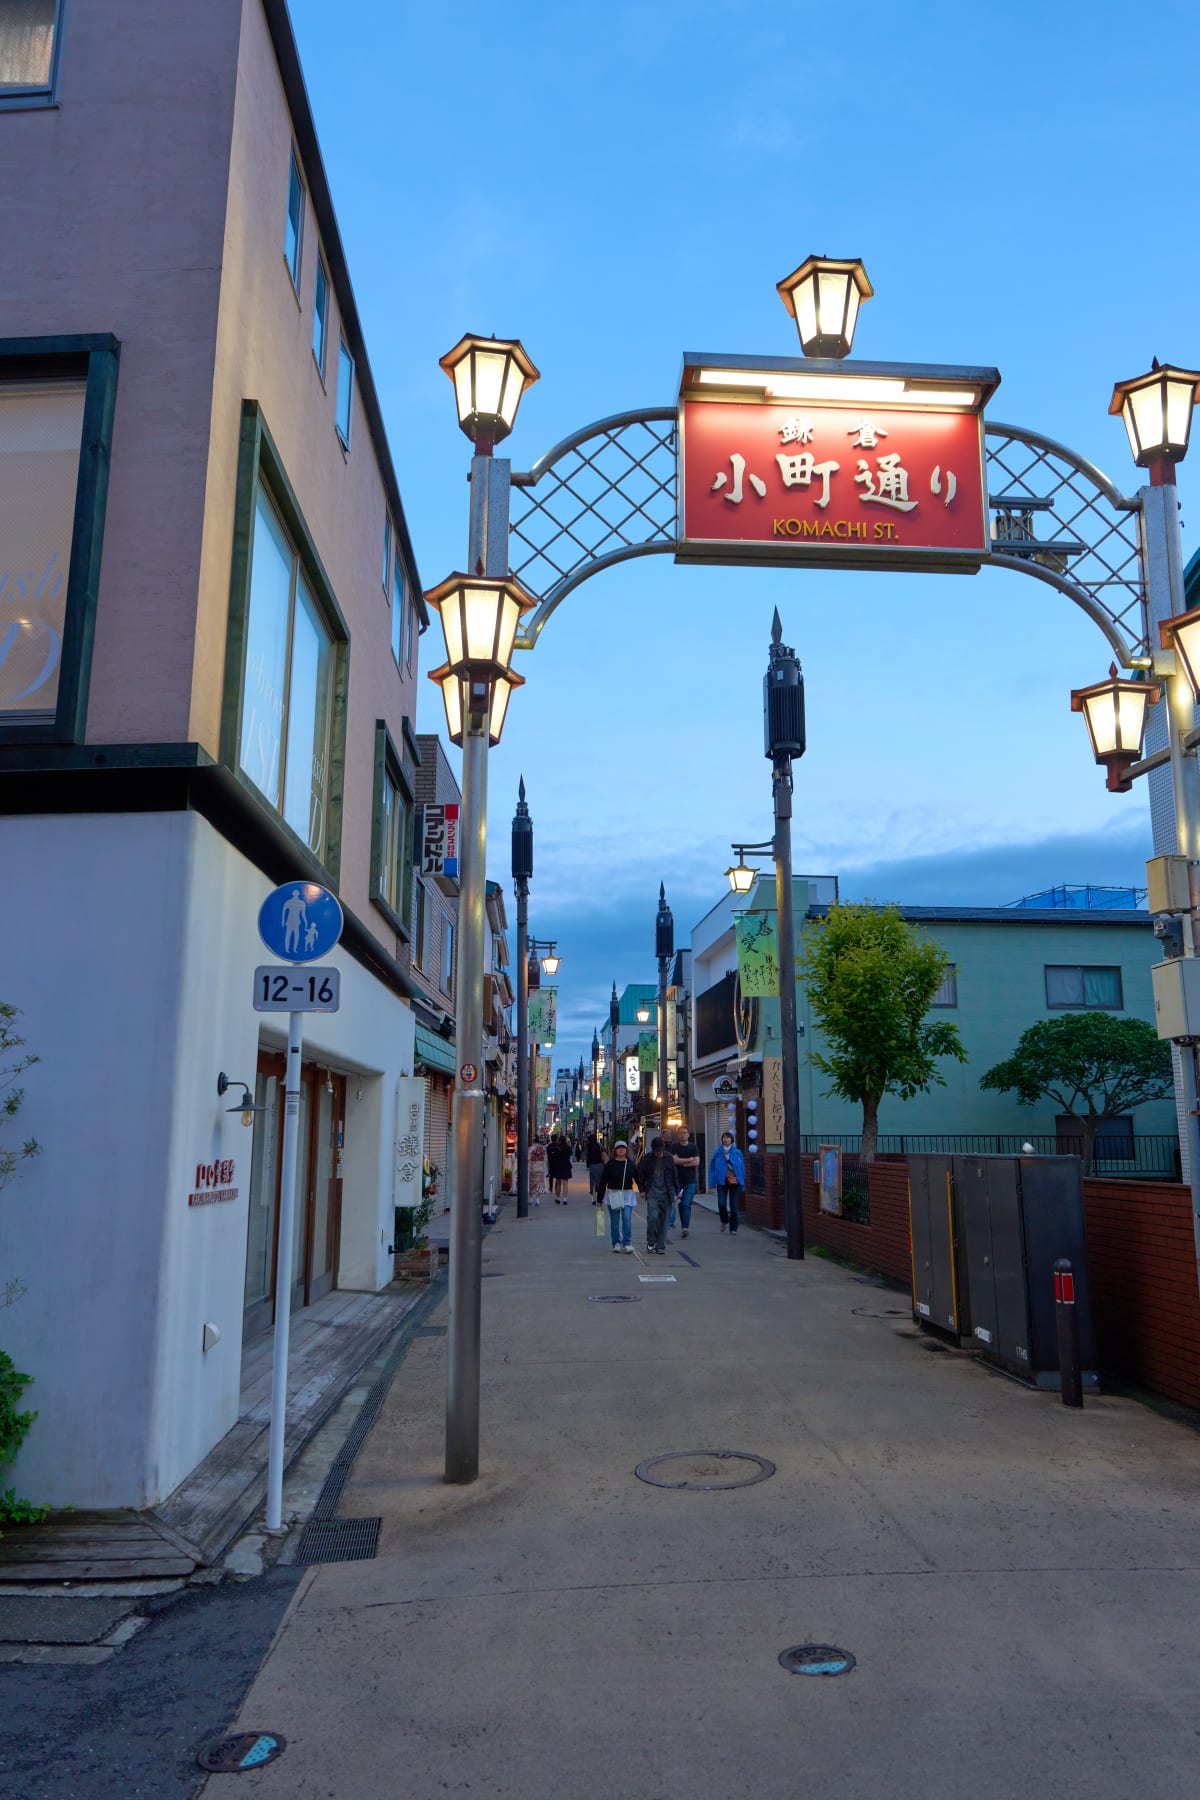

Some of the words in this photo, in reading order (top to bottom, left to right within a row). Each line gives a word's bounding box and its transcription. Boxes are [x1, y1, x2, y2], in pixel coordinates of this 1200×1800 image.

[777, 416, 889, 449] 鎌倉
[711, 451, 958, 513] 小町通り
[772, 518, 868, 539] KOMACHI
[873, 522, 900, 541] ST.
[262, 975, 334, 1003] 12-16
